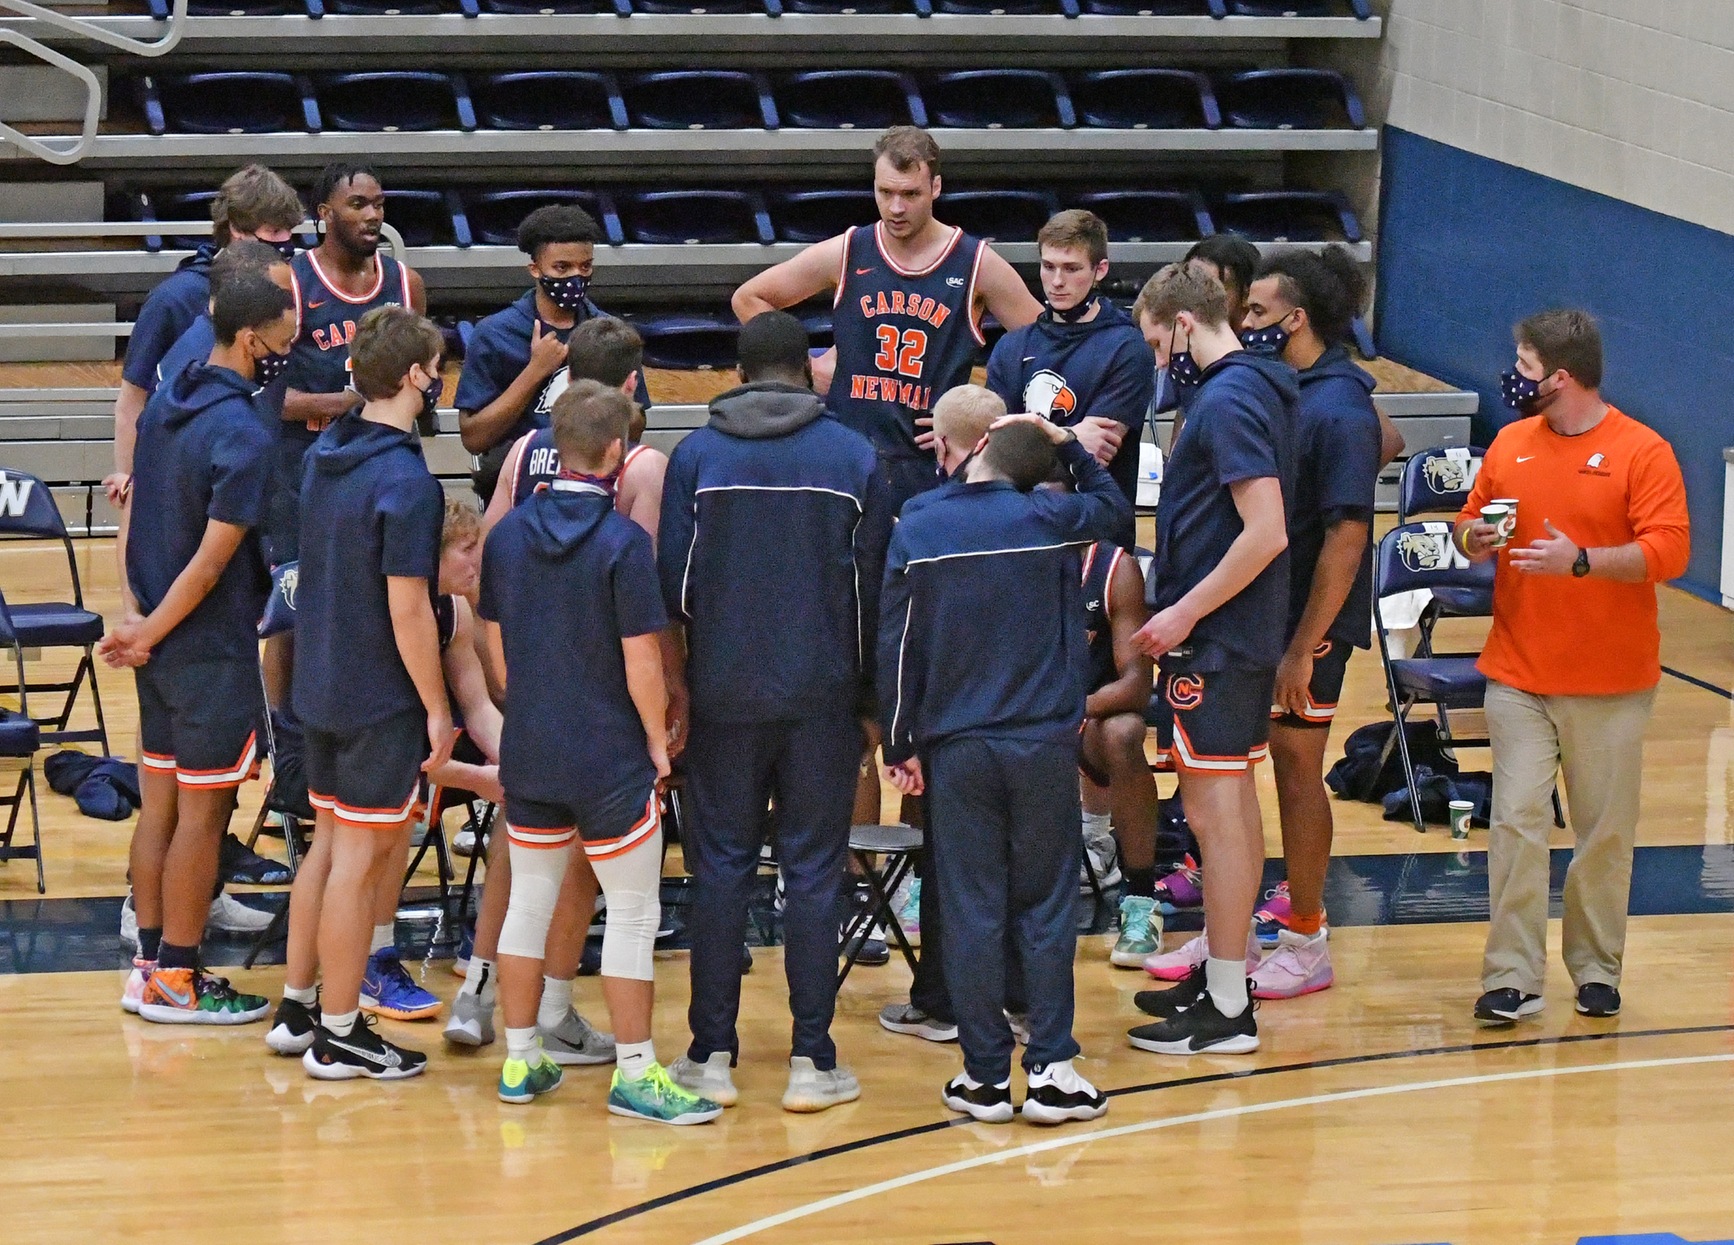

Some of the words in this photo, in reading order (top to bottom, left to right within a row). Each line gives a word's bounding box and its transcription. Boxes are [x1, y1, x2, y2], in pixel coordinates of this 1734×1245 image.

[945, 276, 964, 288] SAC
[860, 290, 951, 329] CARSON
[875, 323, 928, 379] 32
[529, 447, 561, 476] BRE
